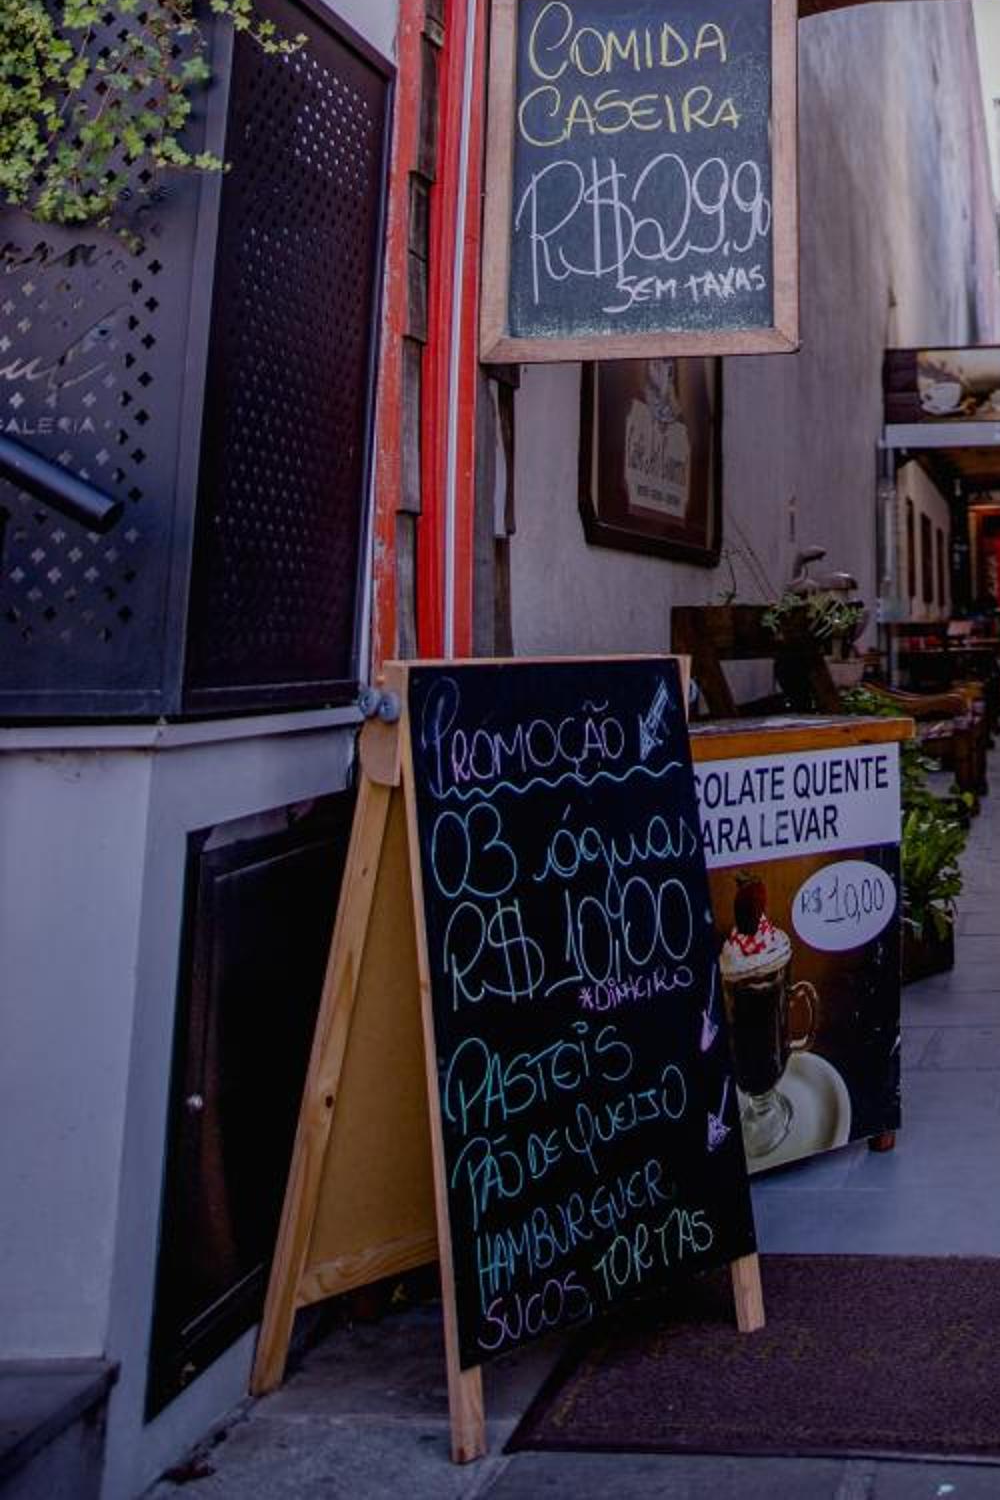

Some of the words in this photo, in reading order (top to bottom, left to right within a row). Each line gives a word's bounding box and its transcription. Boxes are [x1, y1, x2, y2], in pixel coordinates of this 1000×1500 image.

[529, 1, 728, 81] COMIDA
[518, 85, 743, 148] CASEIRA
[602, 273, 678, 313] SEM
[793, 755, 889, 801] QUENTE
[760, 804, 839, 848] LEVAR
[527, 1128, 562, 1179] DE
[592, 1208, 714, 1301] TORTAS
